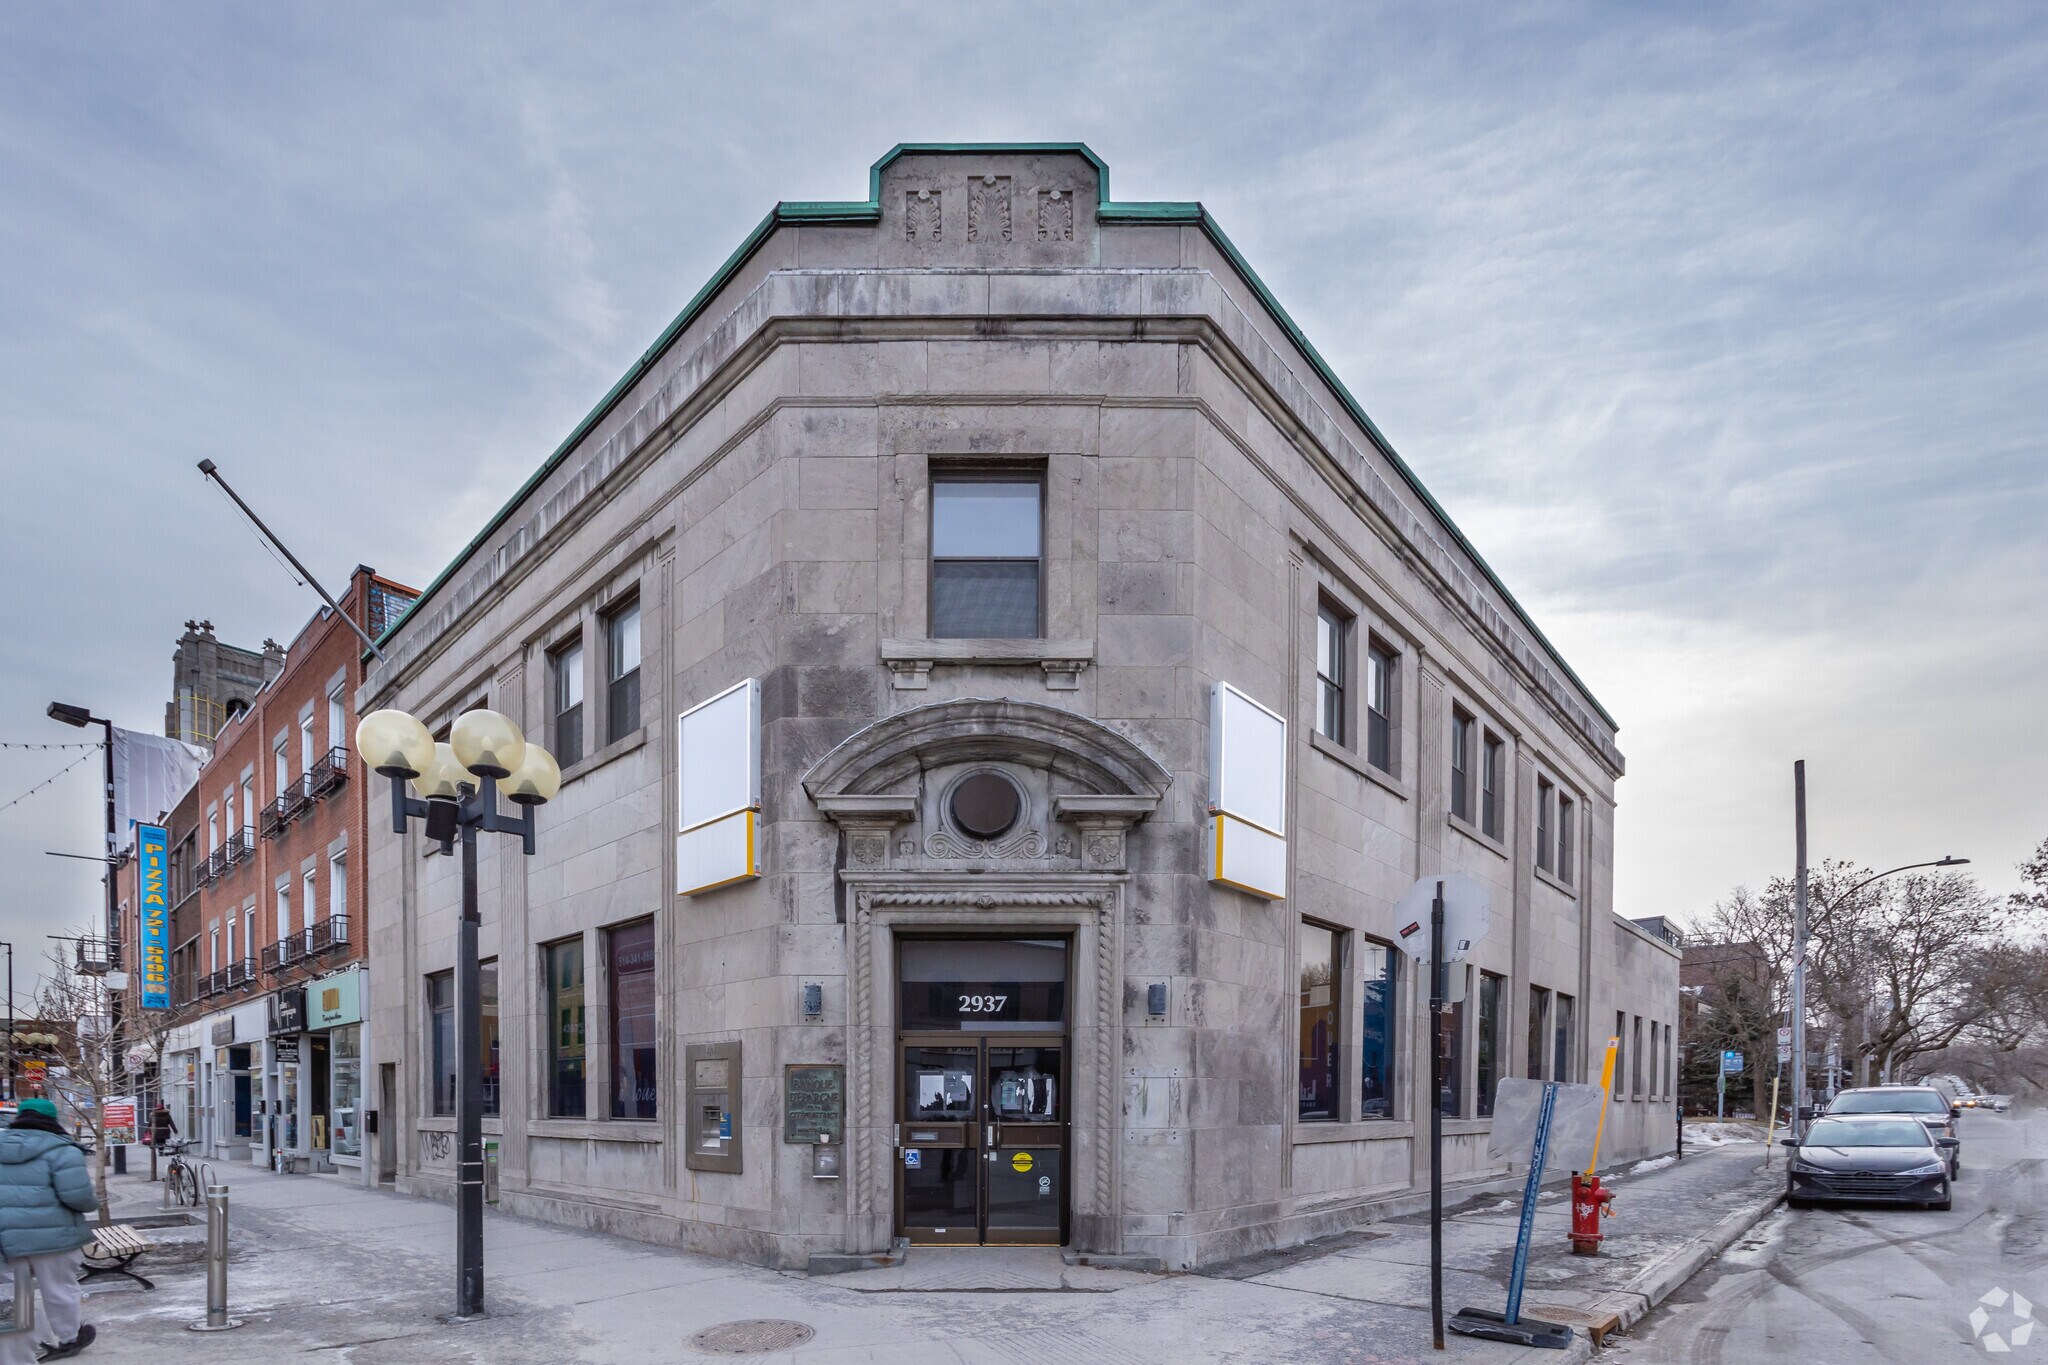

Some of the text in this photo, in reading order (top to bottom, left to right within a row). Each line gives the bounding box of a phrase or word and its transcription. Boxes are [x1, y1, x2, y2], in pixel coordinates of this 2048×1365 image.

[145, 843, 165, 905] PIZZA
[145, 908, 165, 982] 721-5496
[958, 995, 1007, 1012] 2937
[792, 1079, 835, 1090] BANQUE
